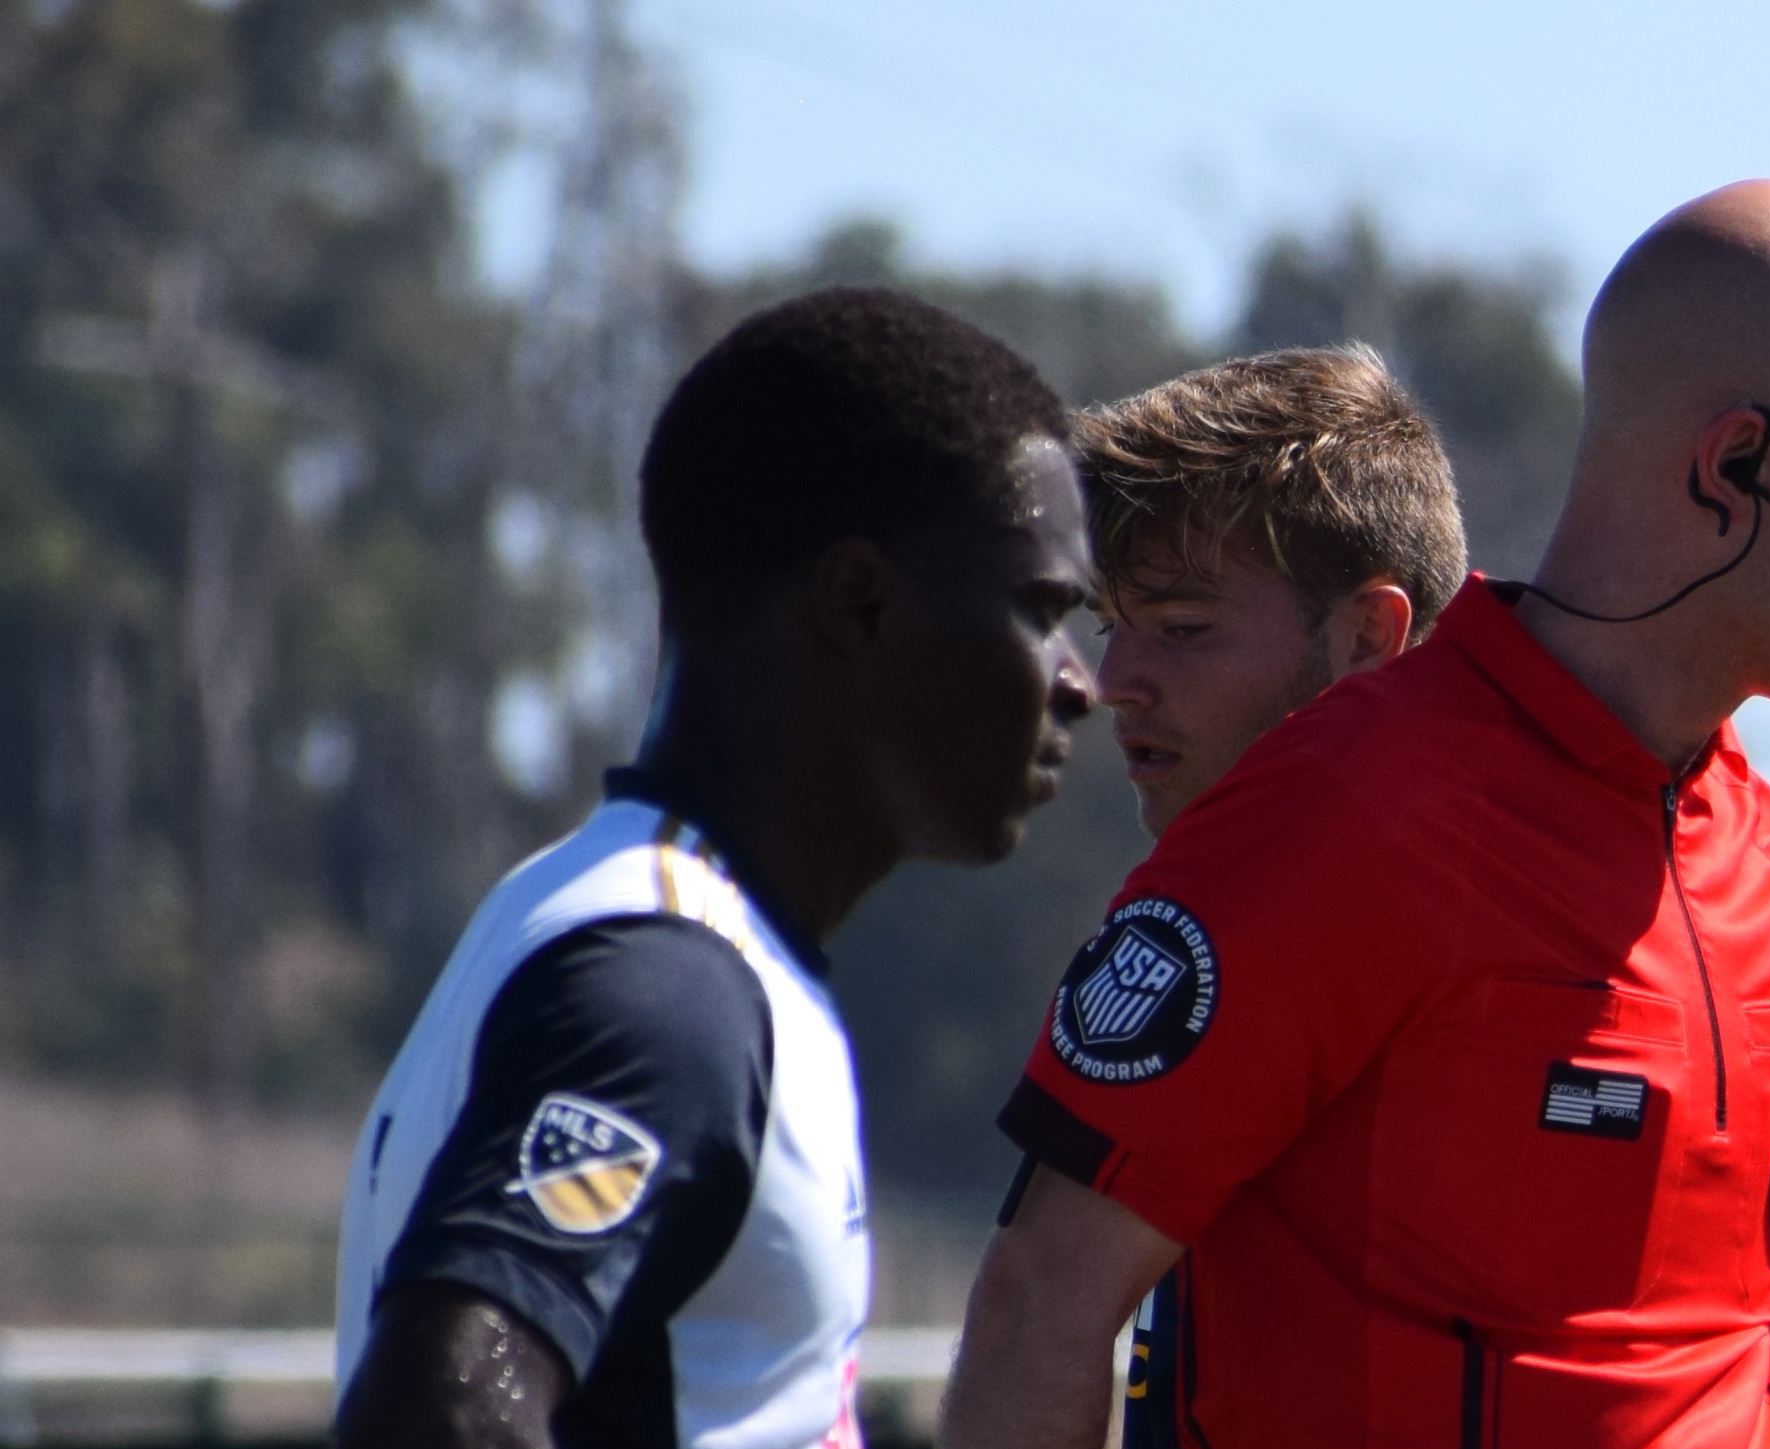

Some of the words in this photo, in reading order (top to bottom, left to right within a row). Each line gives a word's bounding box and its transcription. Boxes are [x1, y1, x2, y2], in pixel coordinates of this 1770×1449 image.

[1113, 935, 1176, 991] USA
[1113, 900, 1177, 924] SOCCER
[1173, 914, 1215, 1034] FEDERATION
[1071, 1053, 1164, 1081] PROGRAM
[1550, 1083, 1594, 1099] OFFICIAL
[545, 1105, 613, 1151] MLS
